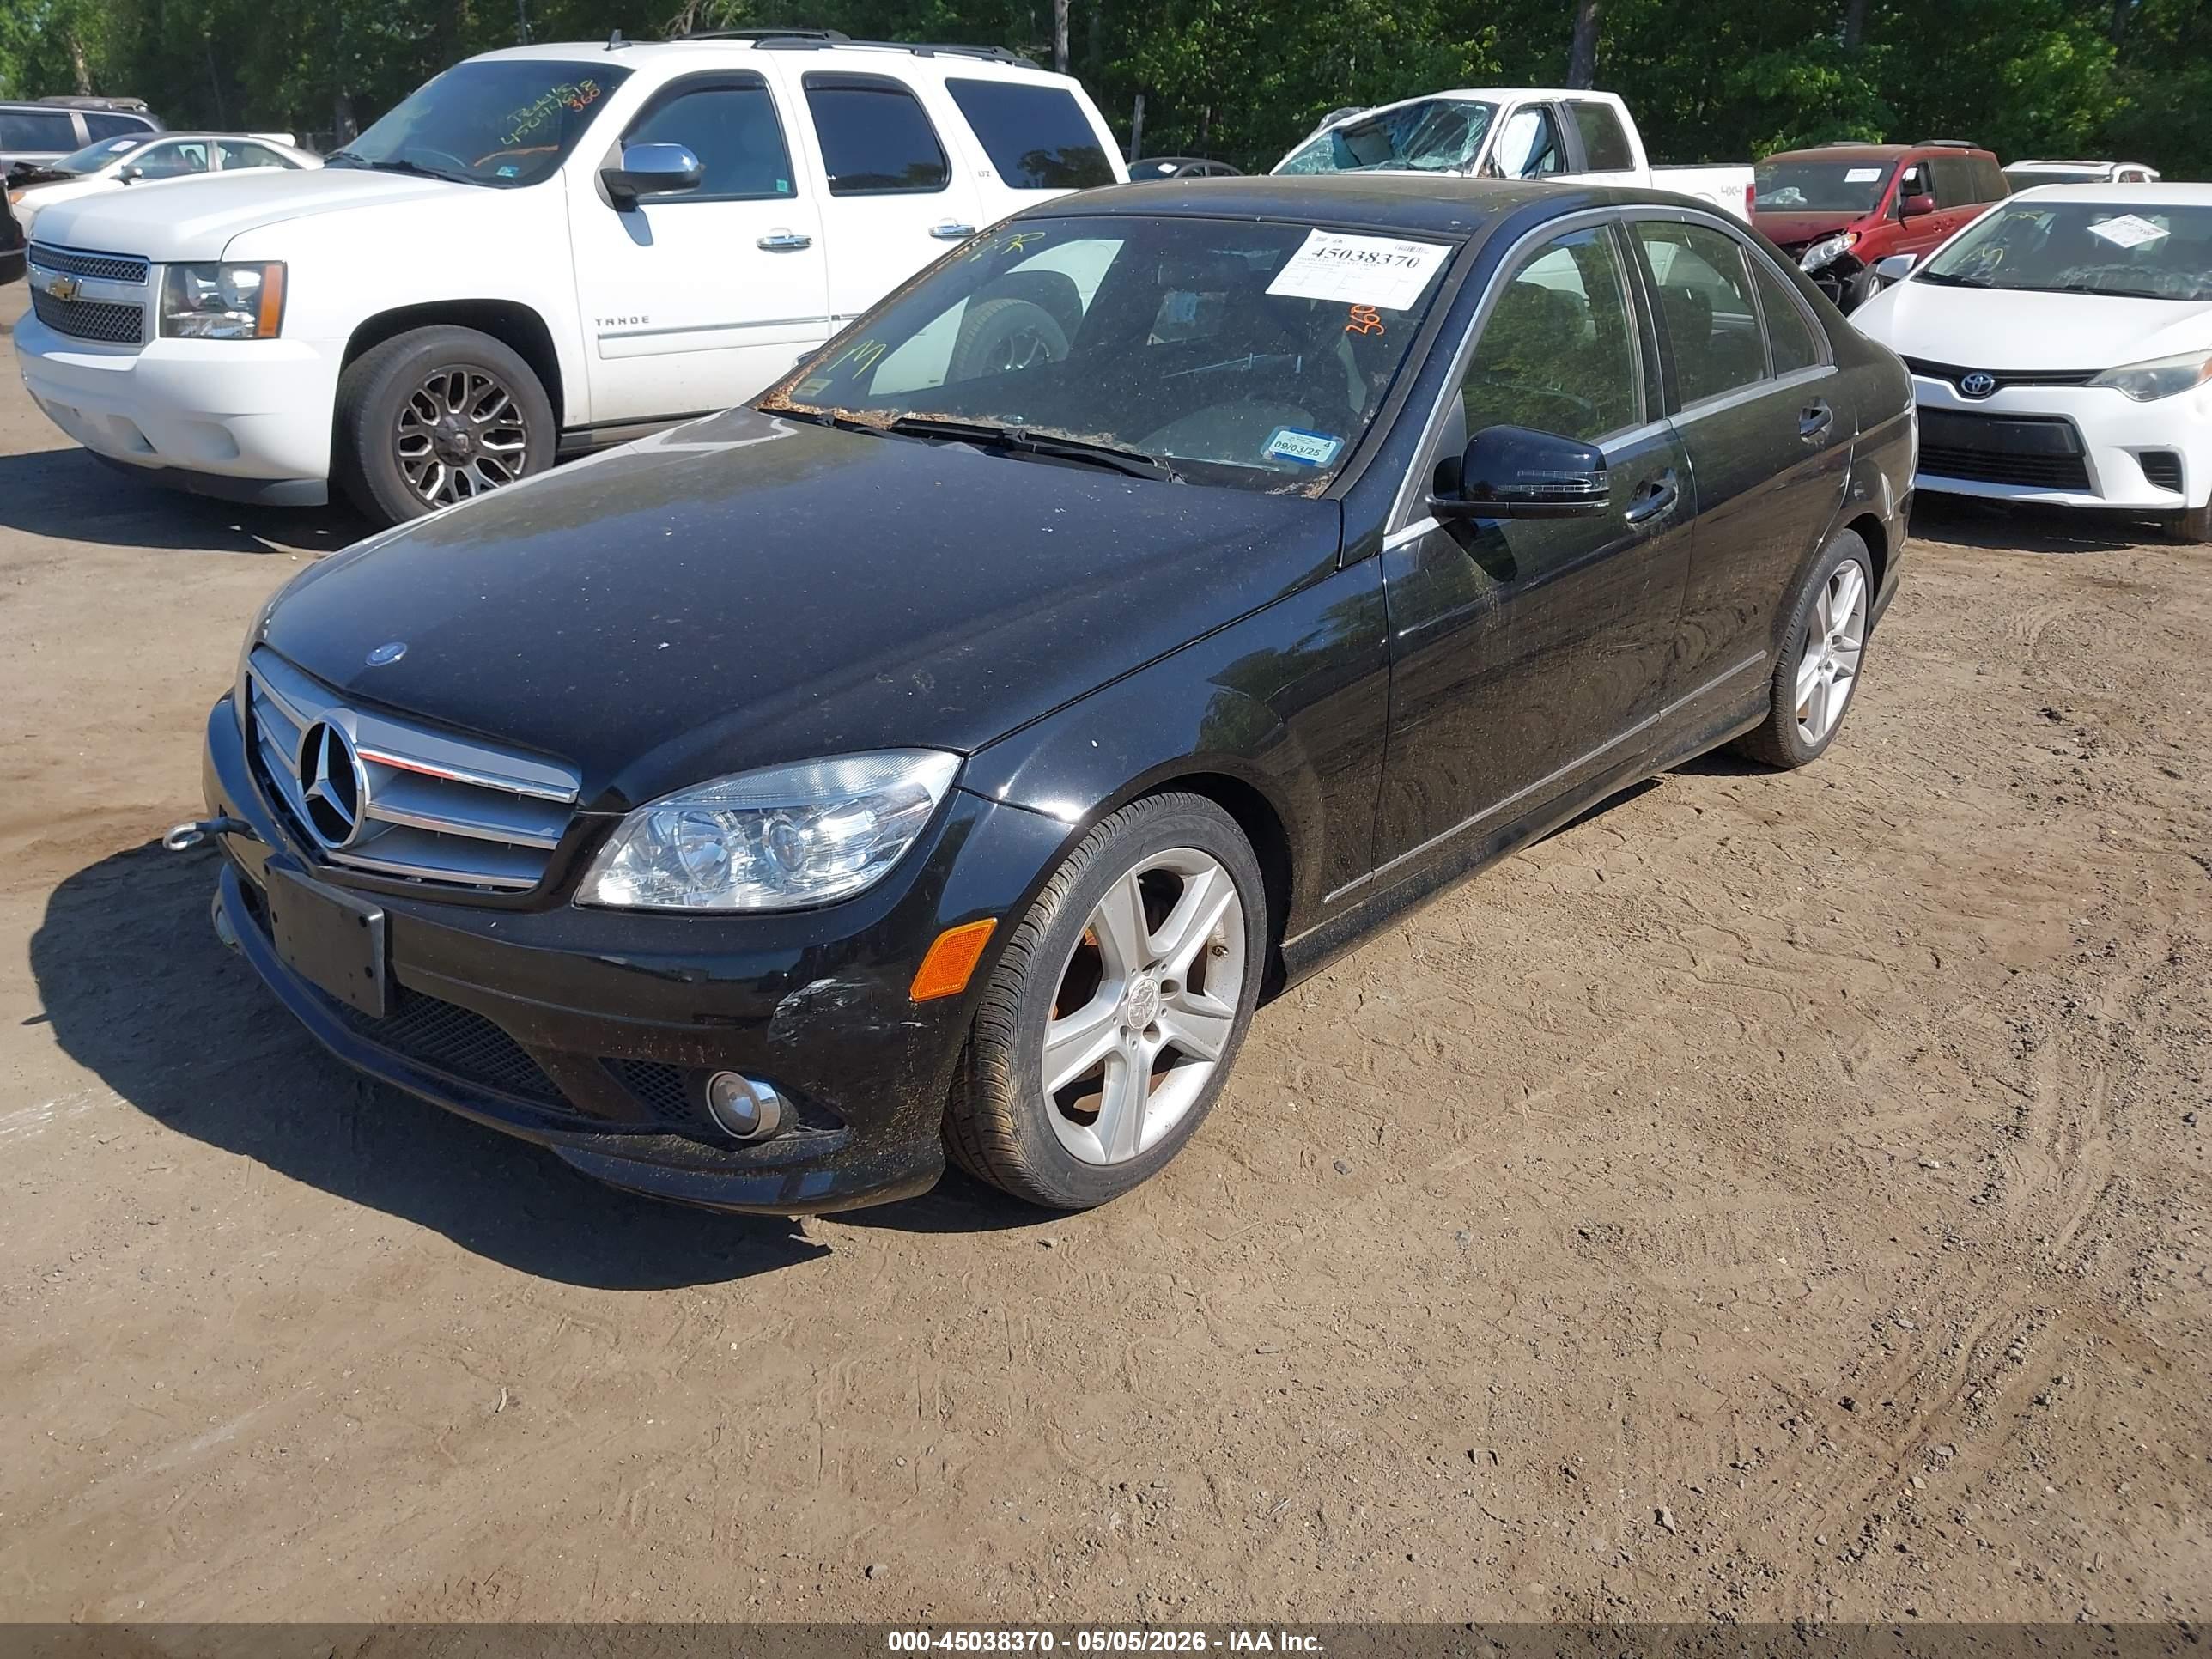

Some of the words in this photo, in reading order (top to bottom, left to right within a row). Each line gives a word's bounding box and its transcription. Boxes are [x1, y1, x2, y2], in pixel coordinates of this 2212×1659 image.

[568, 88, 600, 112] 360
[1311, 246, 1420, 269] 45038370
[595, 316, 650, 326] TAHOE
[1274, 441, 1322, 457] 09/03/25
